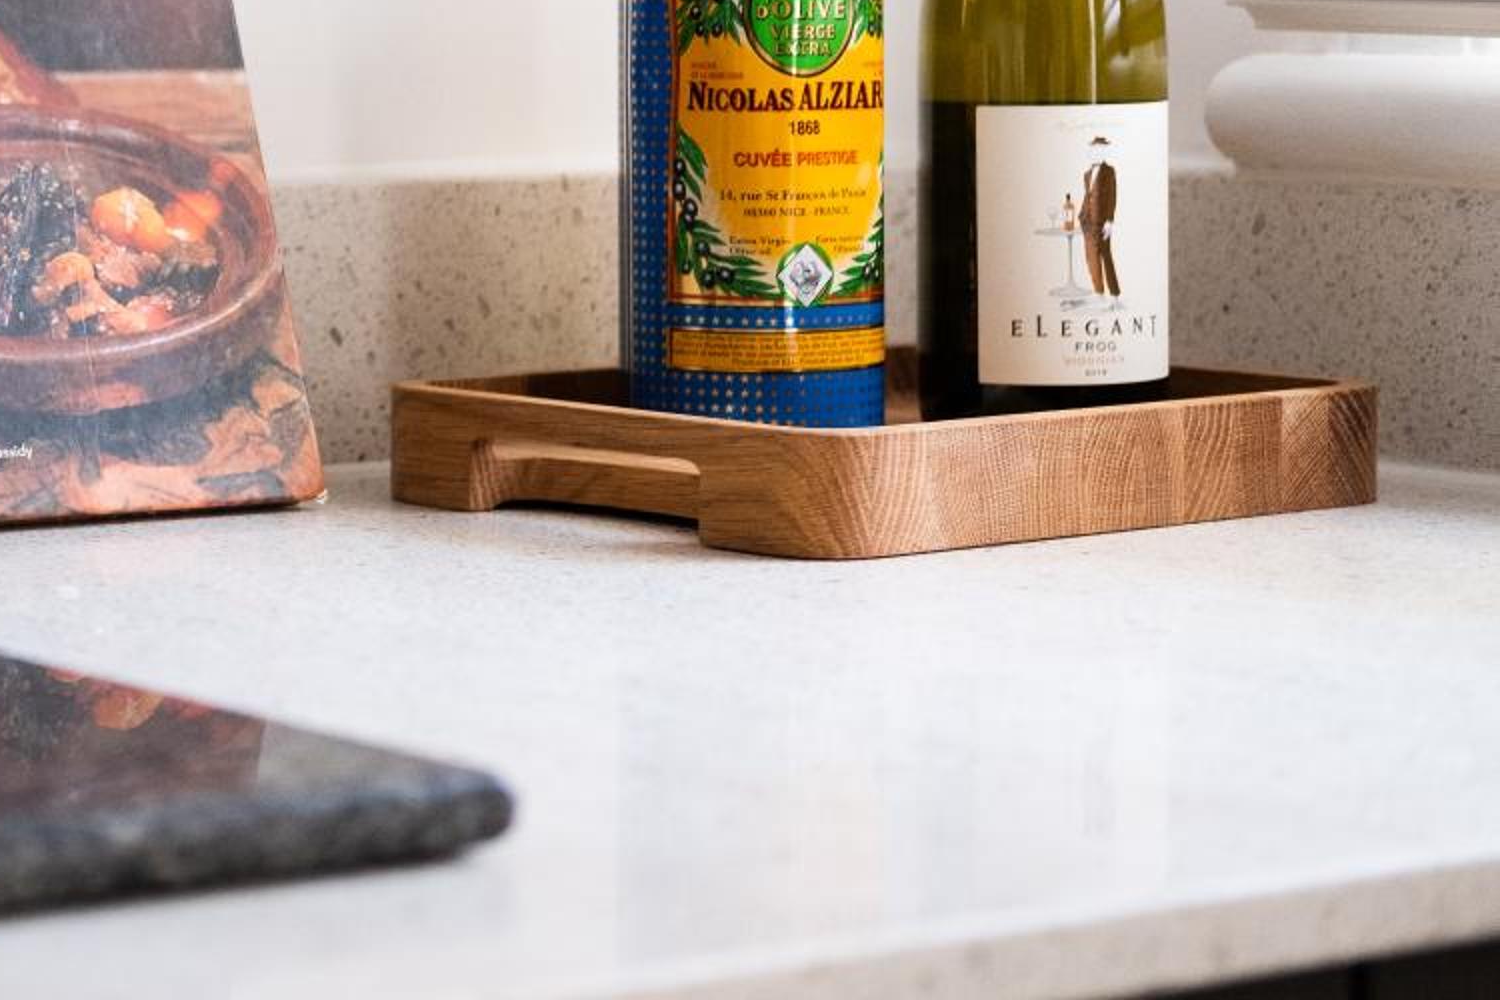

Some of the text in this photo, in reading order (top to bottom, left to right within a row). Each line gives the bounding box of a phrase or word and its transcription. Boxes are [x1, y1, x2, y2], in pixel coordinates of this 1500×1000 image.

[770, 24, 836, 40] VIERGE
[774, 41, 831, 56] EXTRA
[688, 81, 795, 111] NICOLAS
[789, 121, 820, 135] 1868
[734, 149, 858, 168] CUVÉE PRESTIGE
[740, 191, 761, 201] rue
[779, 206, 806, 217] NICE
[1011, 314, 1157, 339] ELEGANT
[1075, 341, 1117, 352] FROG
